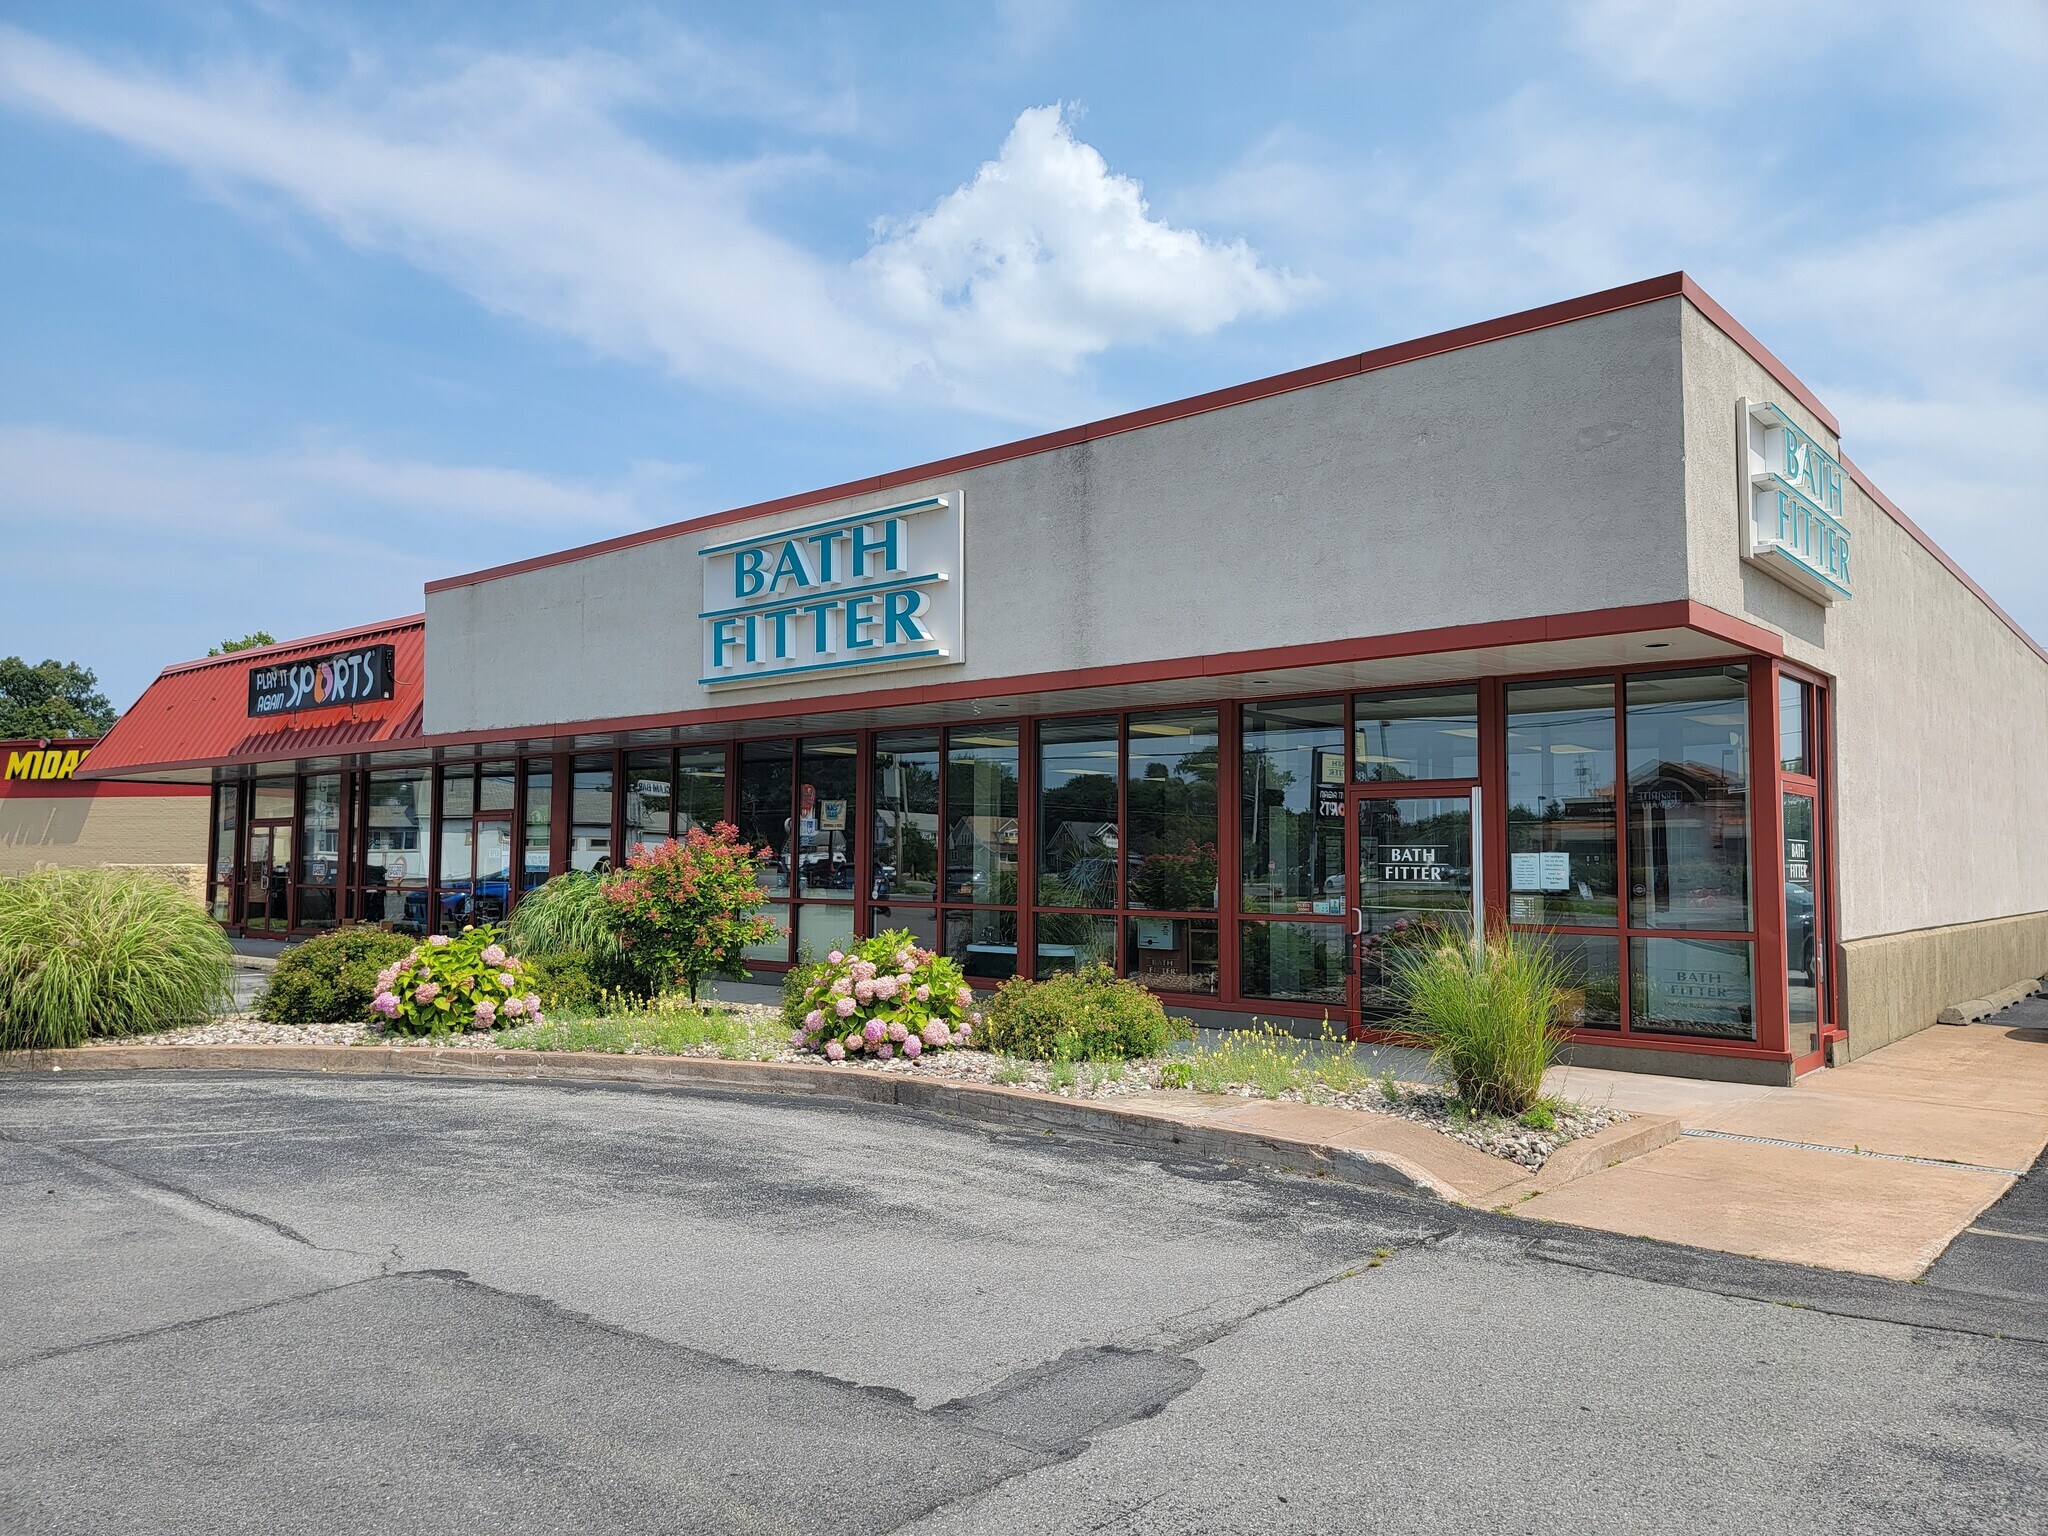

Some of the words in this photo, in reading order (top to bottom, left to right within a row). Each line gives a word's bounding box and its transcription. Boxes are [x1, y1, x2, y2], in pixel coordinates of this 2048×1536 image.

[1785, 425, 1843, 518] BATH
[1777, 489, 1851, 585] FITTER
[734, 518, 905, 599] BATH
[713, 589, 932, 667] FITTER
[256, 671, 278, 691] PLAY
[279, 669, 288, 687] IT
[286, 651, 375, 708] SPORTS
[257, 692, 285, 712] AGAIN
[4, 749, 91, 780] MIDA
[1391, 848, 1435, 862] BATH
[1791, 843, 1806, 858] BATH
[1385, 866, 1442, 880] FITTER
[1790, 863, 1808, 879] FITTER
[1676, 971, 1721, 984] BATH
[1670, 985, 1727, 998] FITTER
